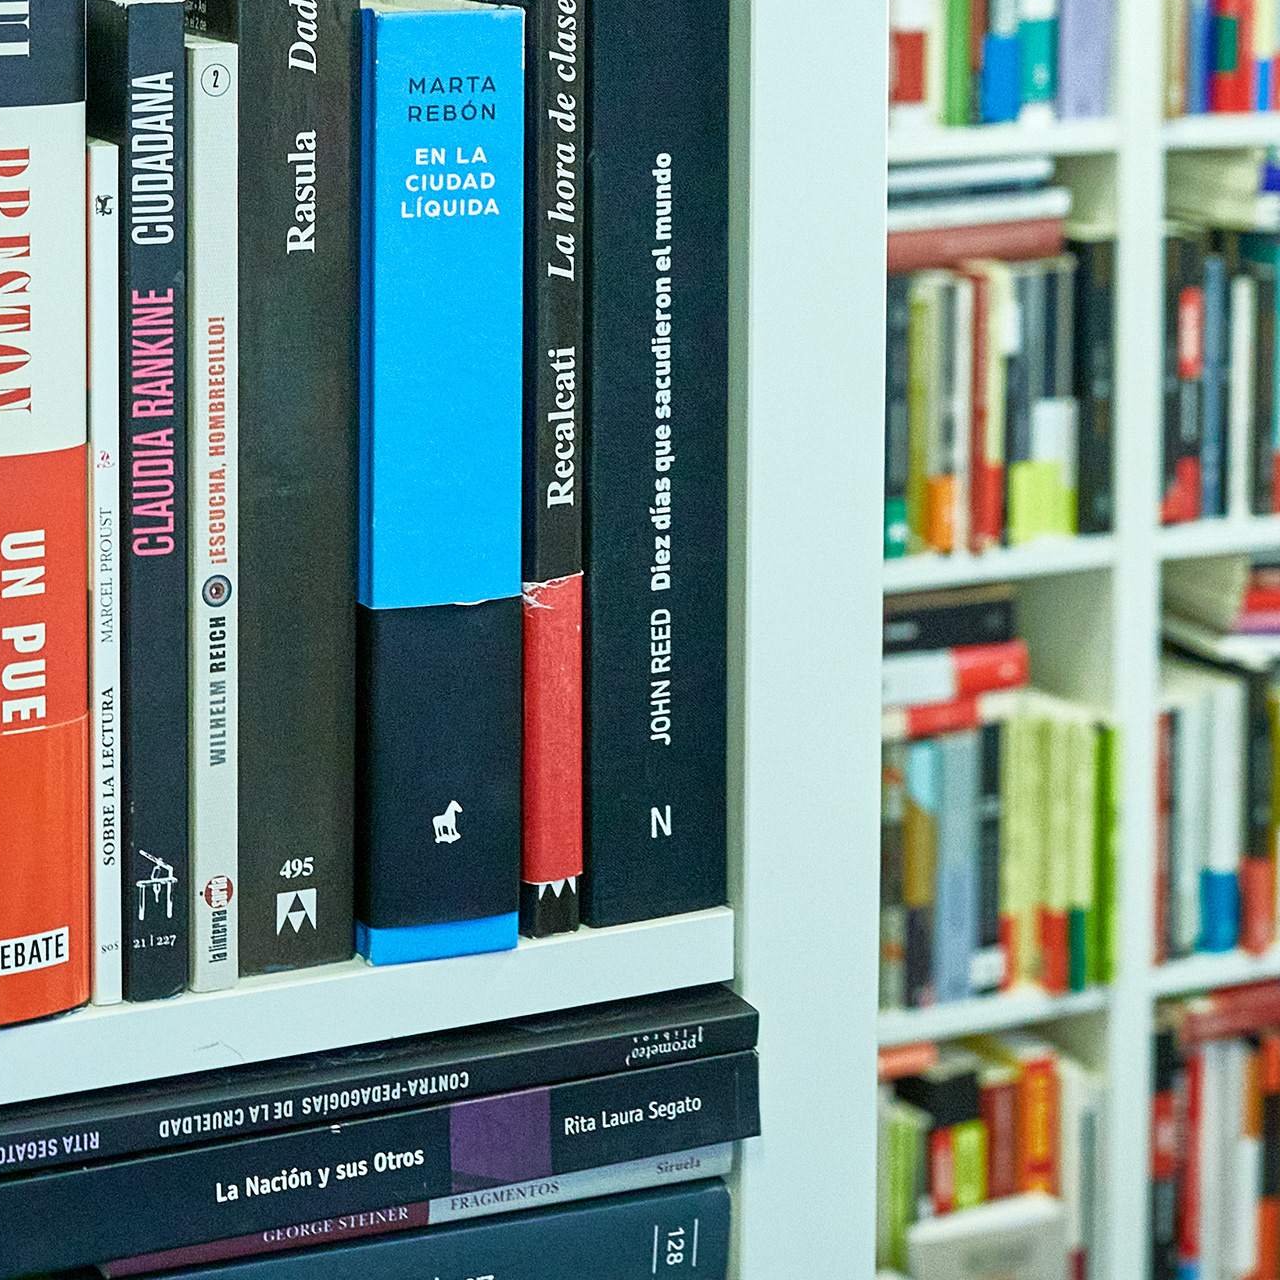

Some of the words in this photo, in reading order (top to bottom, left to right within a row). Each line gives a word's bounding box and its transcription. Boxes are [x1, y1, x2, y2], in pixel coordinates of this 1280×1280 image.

[409, 76, 496, 94] MARTA
[409, 100, 495, 122] REBÓN
[549, 93, 575, 132] de
[132, 72, 174, 244] CIUDADANA
[406, 172, 495, 192] CIUDAD
[416, 148, 445, 165] EN
[457, 147, 487, 164] LA
[548, 142, 576, 222] hora
[287, 130, 316, 254] Rasula
[401, 196, 499, 218] LÍQUIDA
[652, 153, 672, 239] mundo
[548, 233, 575, 282] La
[652, 246, 671, 271] el
[132, 289, 173, 417] RANKINE
[652, 277, 671, 419] sacudieron
[208, 317, 225, 456] HOMBRECILLO!
[547, 347, 575, 508] Recalcati
[656, 425, 675, 471] que
[133, 428, 174, 556] CLAUDIA
[650, 477, 671, 529] días
[100, 508, 112, 572] PROUST
[651, 535, 670, 591] Diez
[101, 582, 113, 642] MARCEL
[209, 617, 226, 673] REICH
[651, 609, 671, 673] REED
[102, 687, 114, 768] LECTURA
[210, 680, 226, 766] WILHELM
[651, 680, 671, 745] JOHN
[103, 776, 115, 803] LA
[103, 806, 116, 865] SOBRE
[280, 857, 313, 878] 495
[565, 1116, 596, 1135] Rita
[602, 1109, 643, 1128] Laura
[649, 1097, 701, 1120] Segato
[216, 1183, 238, 1202] La
[246, 1168, 311, 1197] Nación
[318, 1167, 330, 1188] y
[336, 1160, 367, 1179] sus
[374, 1150, 424, 1172] Otros
[263, 1220, 332, 1242] GEORGE
[339, 1205, 408, 1229] STEINER
[450, 1181, 560, 1210] FRAGMENTOS
[656, 1157, 701, 1176] Siruela
[667, 1227, 684, 1265] 128
